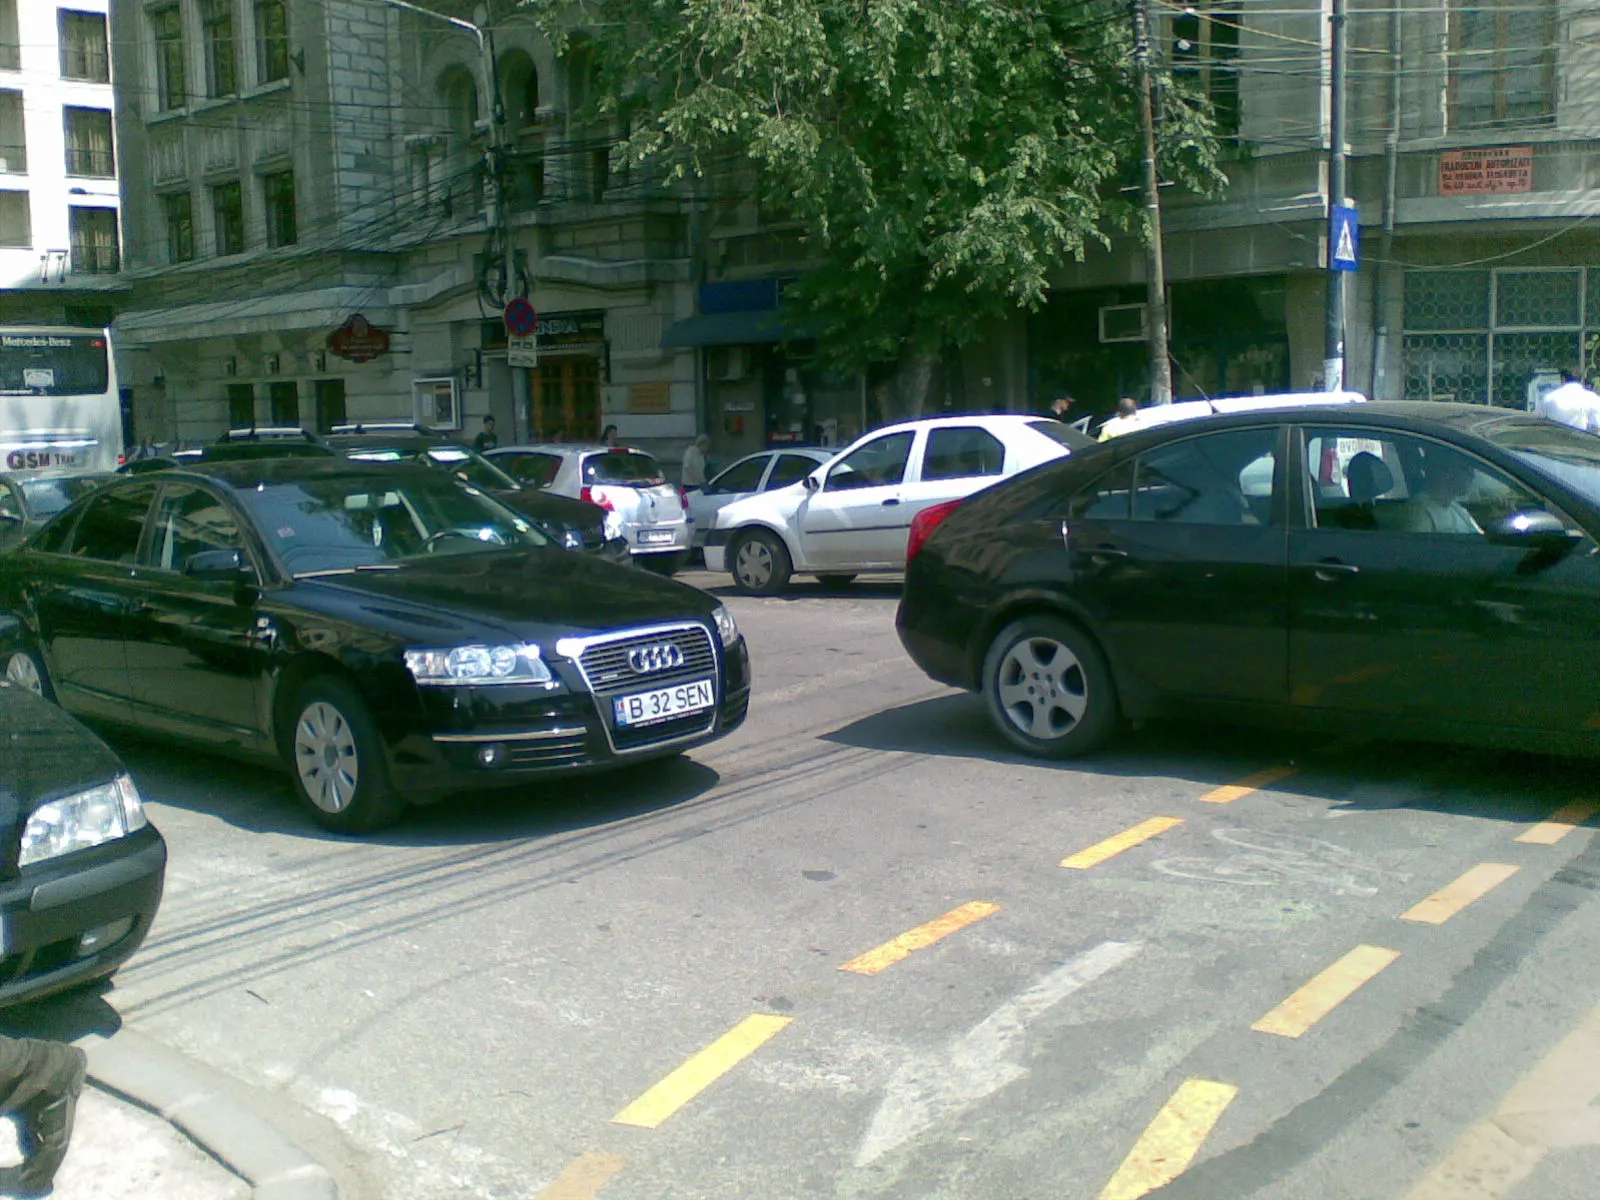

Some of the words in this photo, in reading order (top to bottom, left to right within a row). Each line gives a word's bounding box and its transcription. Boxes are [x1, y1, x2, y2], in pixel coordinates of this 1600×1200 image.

[629, 697, 643, 719] B
[650, 692, 671, 714] 32
[675, 682, 710, 709] SEN
